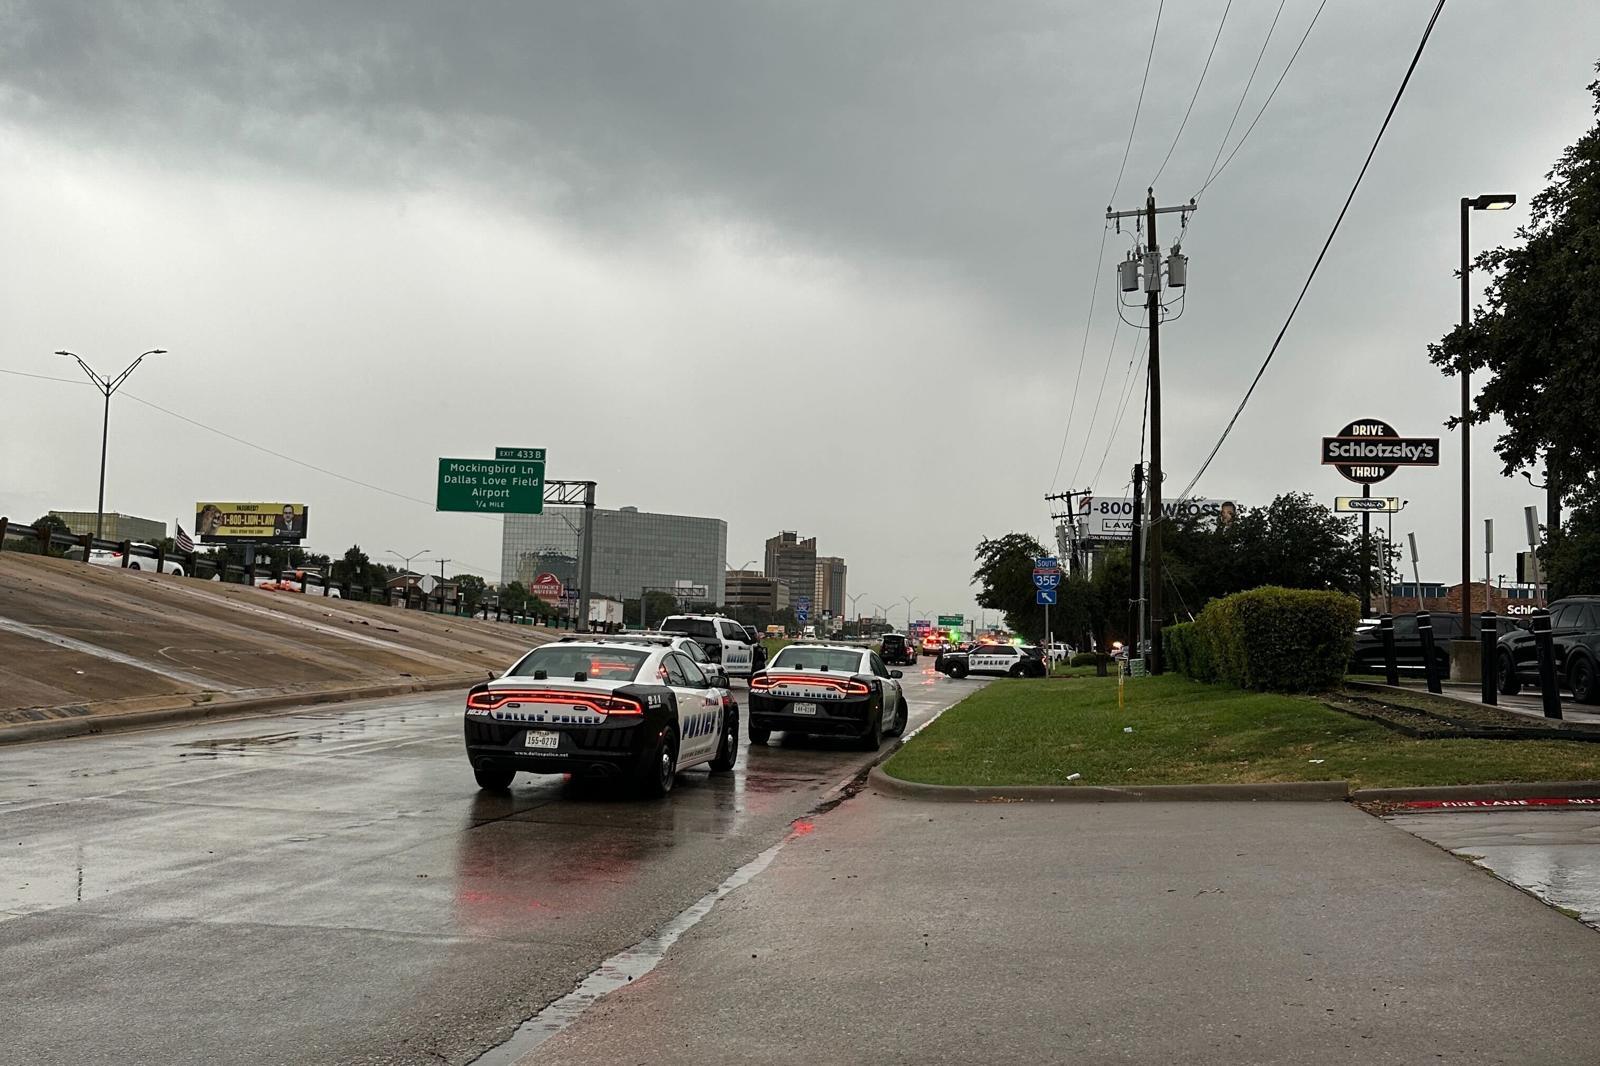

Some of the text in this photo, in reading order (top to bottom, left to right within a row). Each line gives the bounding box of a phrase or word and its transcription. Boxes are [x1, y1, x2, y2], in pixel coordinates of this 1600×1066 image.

[1352, 425, 1383, 436] DRIVE
[1329, 442, 1433, 460] Schlotzsky's
[450, 463, 534, 474] Mockingbird Ln
[1350, 466, 1378, 477] THRU
[444, 475, 539, 486] Dallas Love Field
[471, 488, 510, 499] Airport
[223, 514, 276, 526] 1-800-LION-LAW
[1037, 559, 1057, 567] SOUTH
[1036, 575, 1057, 586] 35E
[1507, 604, 1539, 615] Schlo
[496, 712, 600, 724] DALLAS POLICE
[682, 711, 718, 740] POLICE
[1481, 799, 1529, 807] LANE
